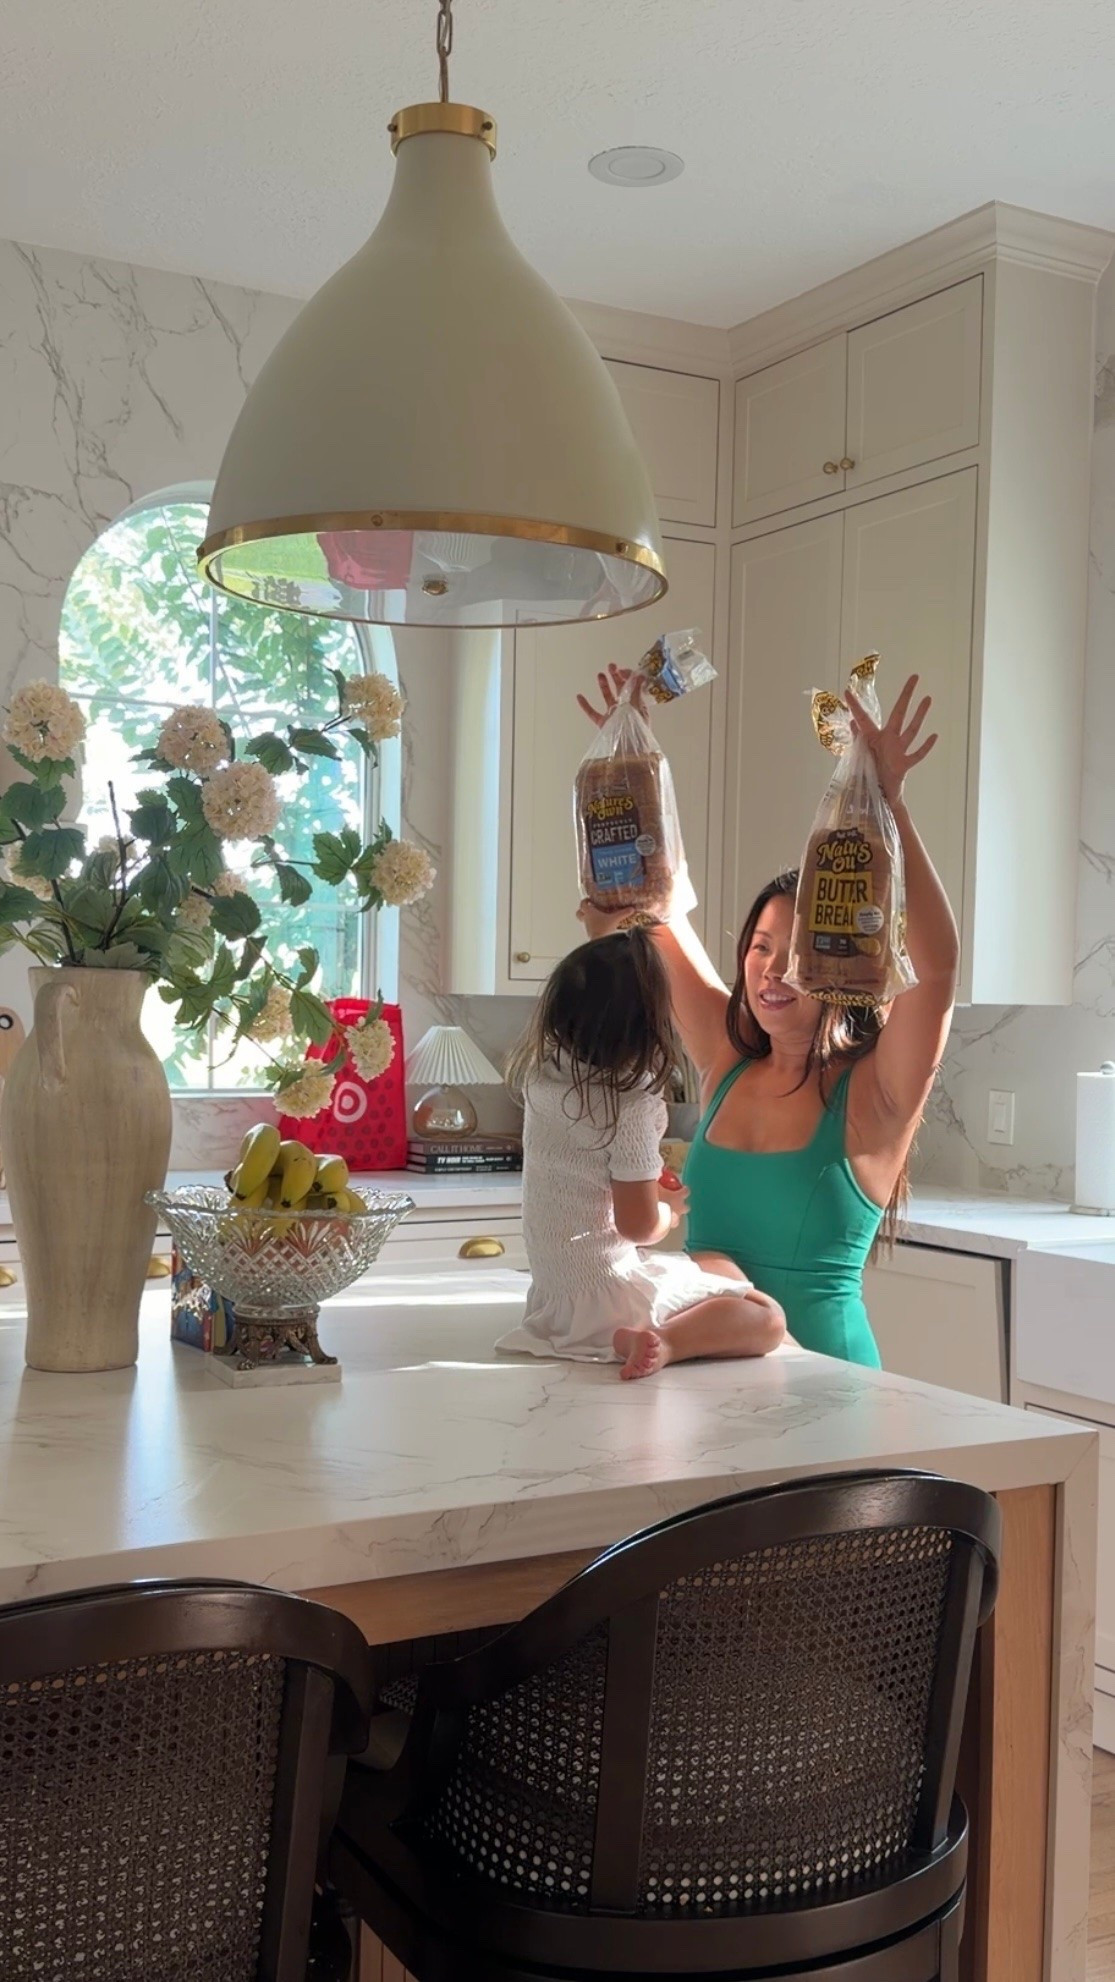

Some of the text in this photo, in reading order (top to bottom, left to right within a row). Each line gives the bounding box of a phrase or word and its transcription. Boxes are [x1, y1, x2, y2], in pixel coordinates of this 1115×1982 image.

[591, 824, 638, 846] CRAFTED
[598, 853, 638, 868] WHITE
[816, 878, 869, 904] BUTTR
[814, 903, 854, 926] BREA
